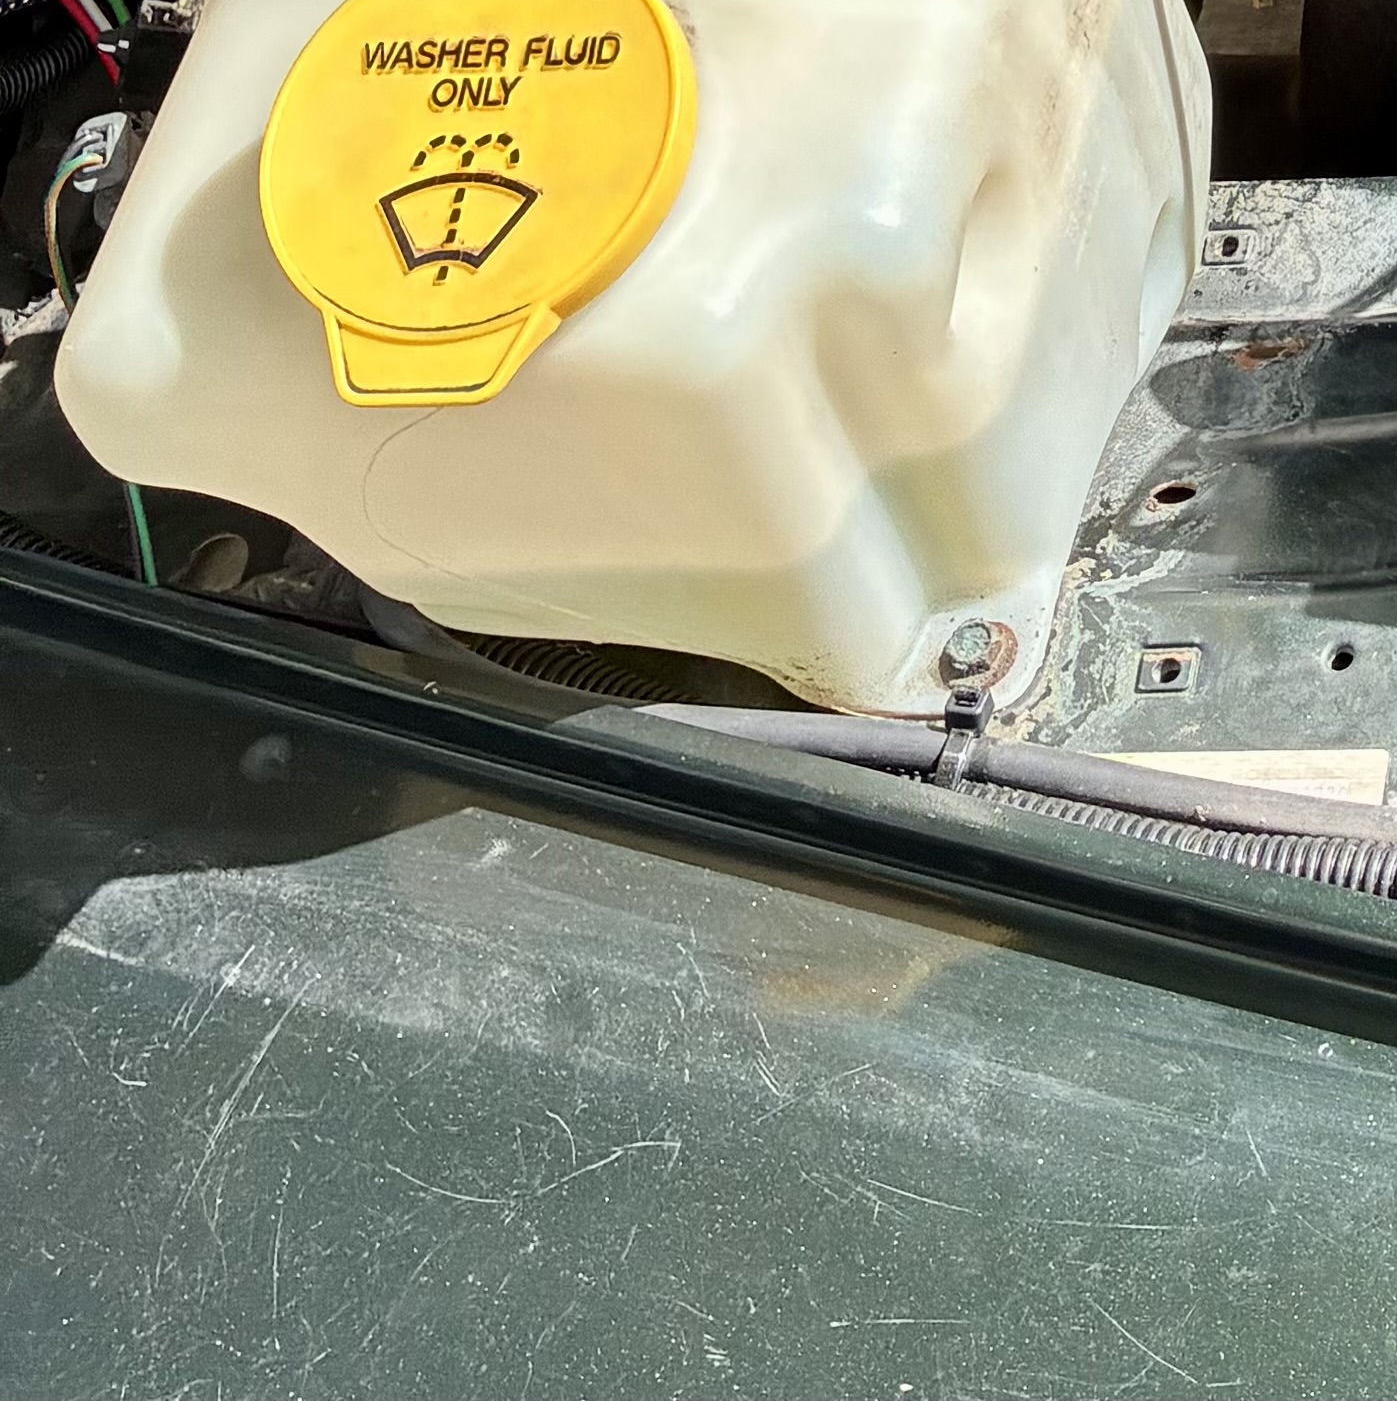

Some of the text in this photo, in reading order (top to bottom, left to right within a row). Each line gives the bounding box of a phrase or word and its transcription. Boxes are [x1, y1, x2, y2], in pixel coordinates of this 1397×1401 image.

[363, 33, 622, 74] WASHER FLUID
[429, 76, 523, 112] ONLY
